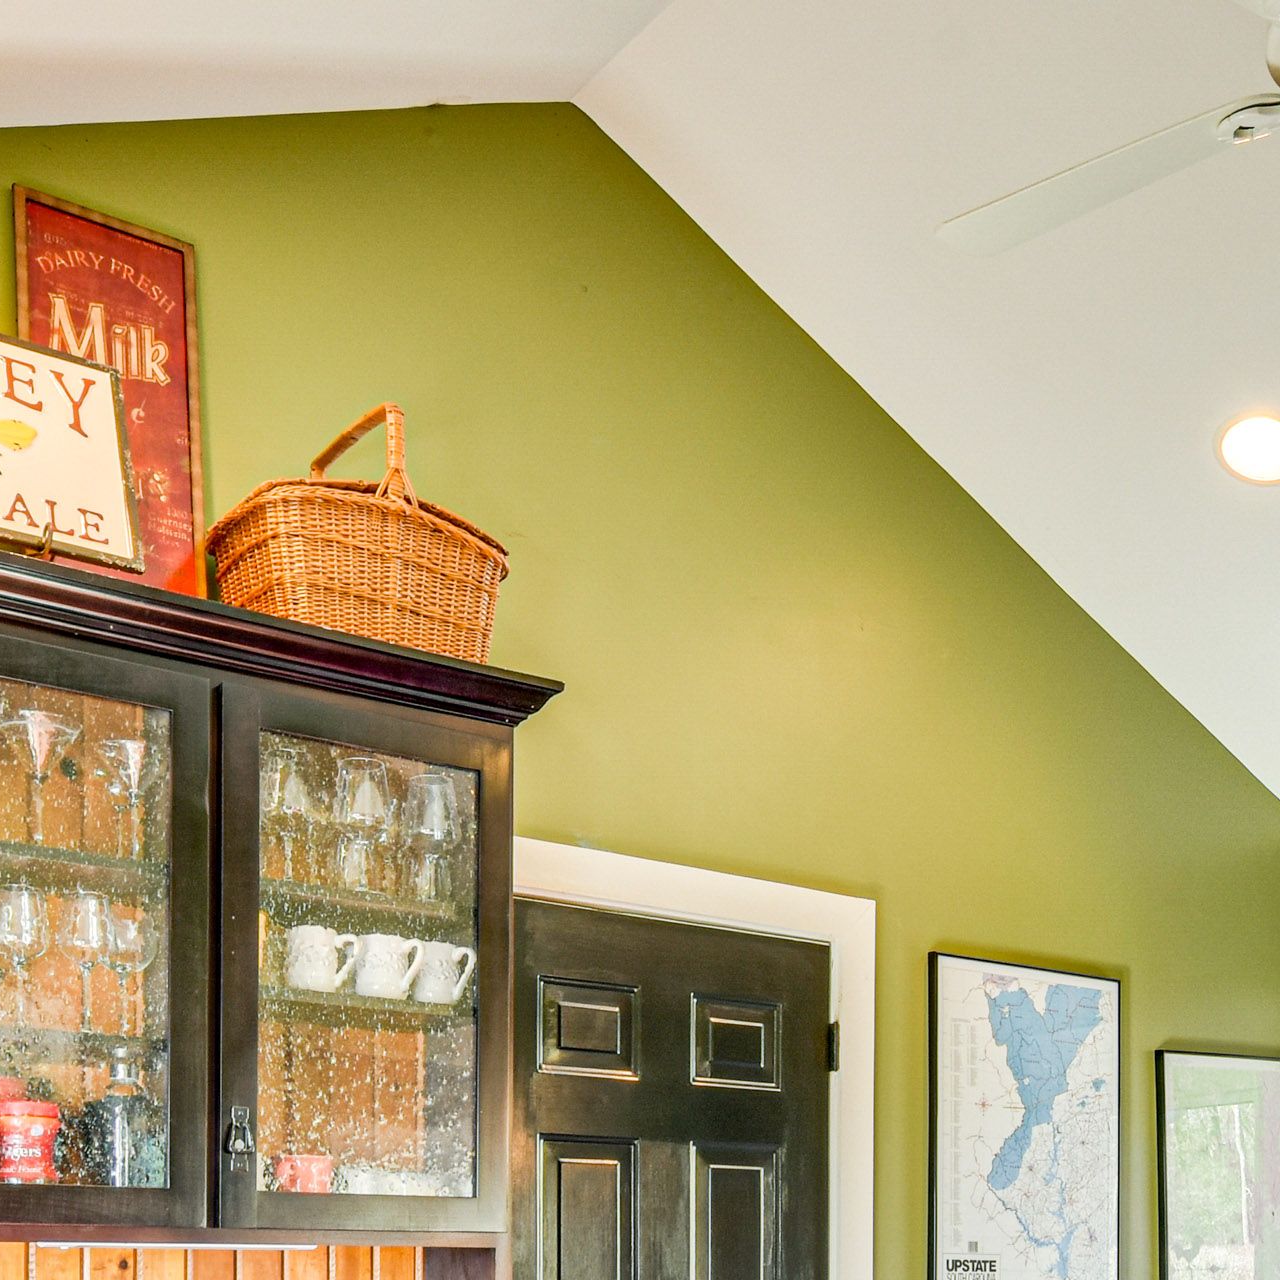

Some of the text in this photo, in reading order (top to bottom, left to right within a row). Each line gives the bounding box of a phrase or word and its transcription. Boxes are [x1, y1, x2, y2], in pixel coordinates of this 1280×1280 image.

[36, 250, 104, 274] DAIRY
[110, 258, 176, 315] FRESH
[48, 293, 170, 387] Milk
[946, 1259, 997, 1272] UPSTATE
